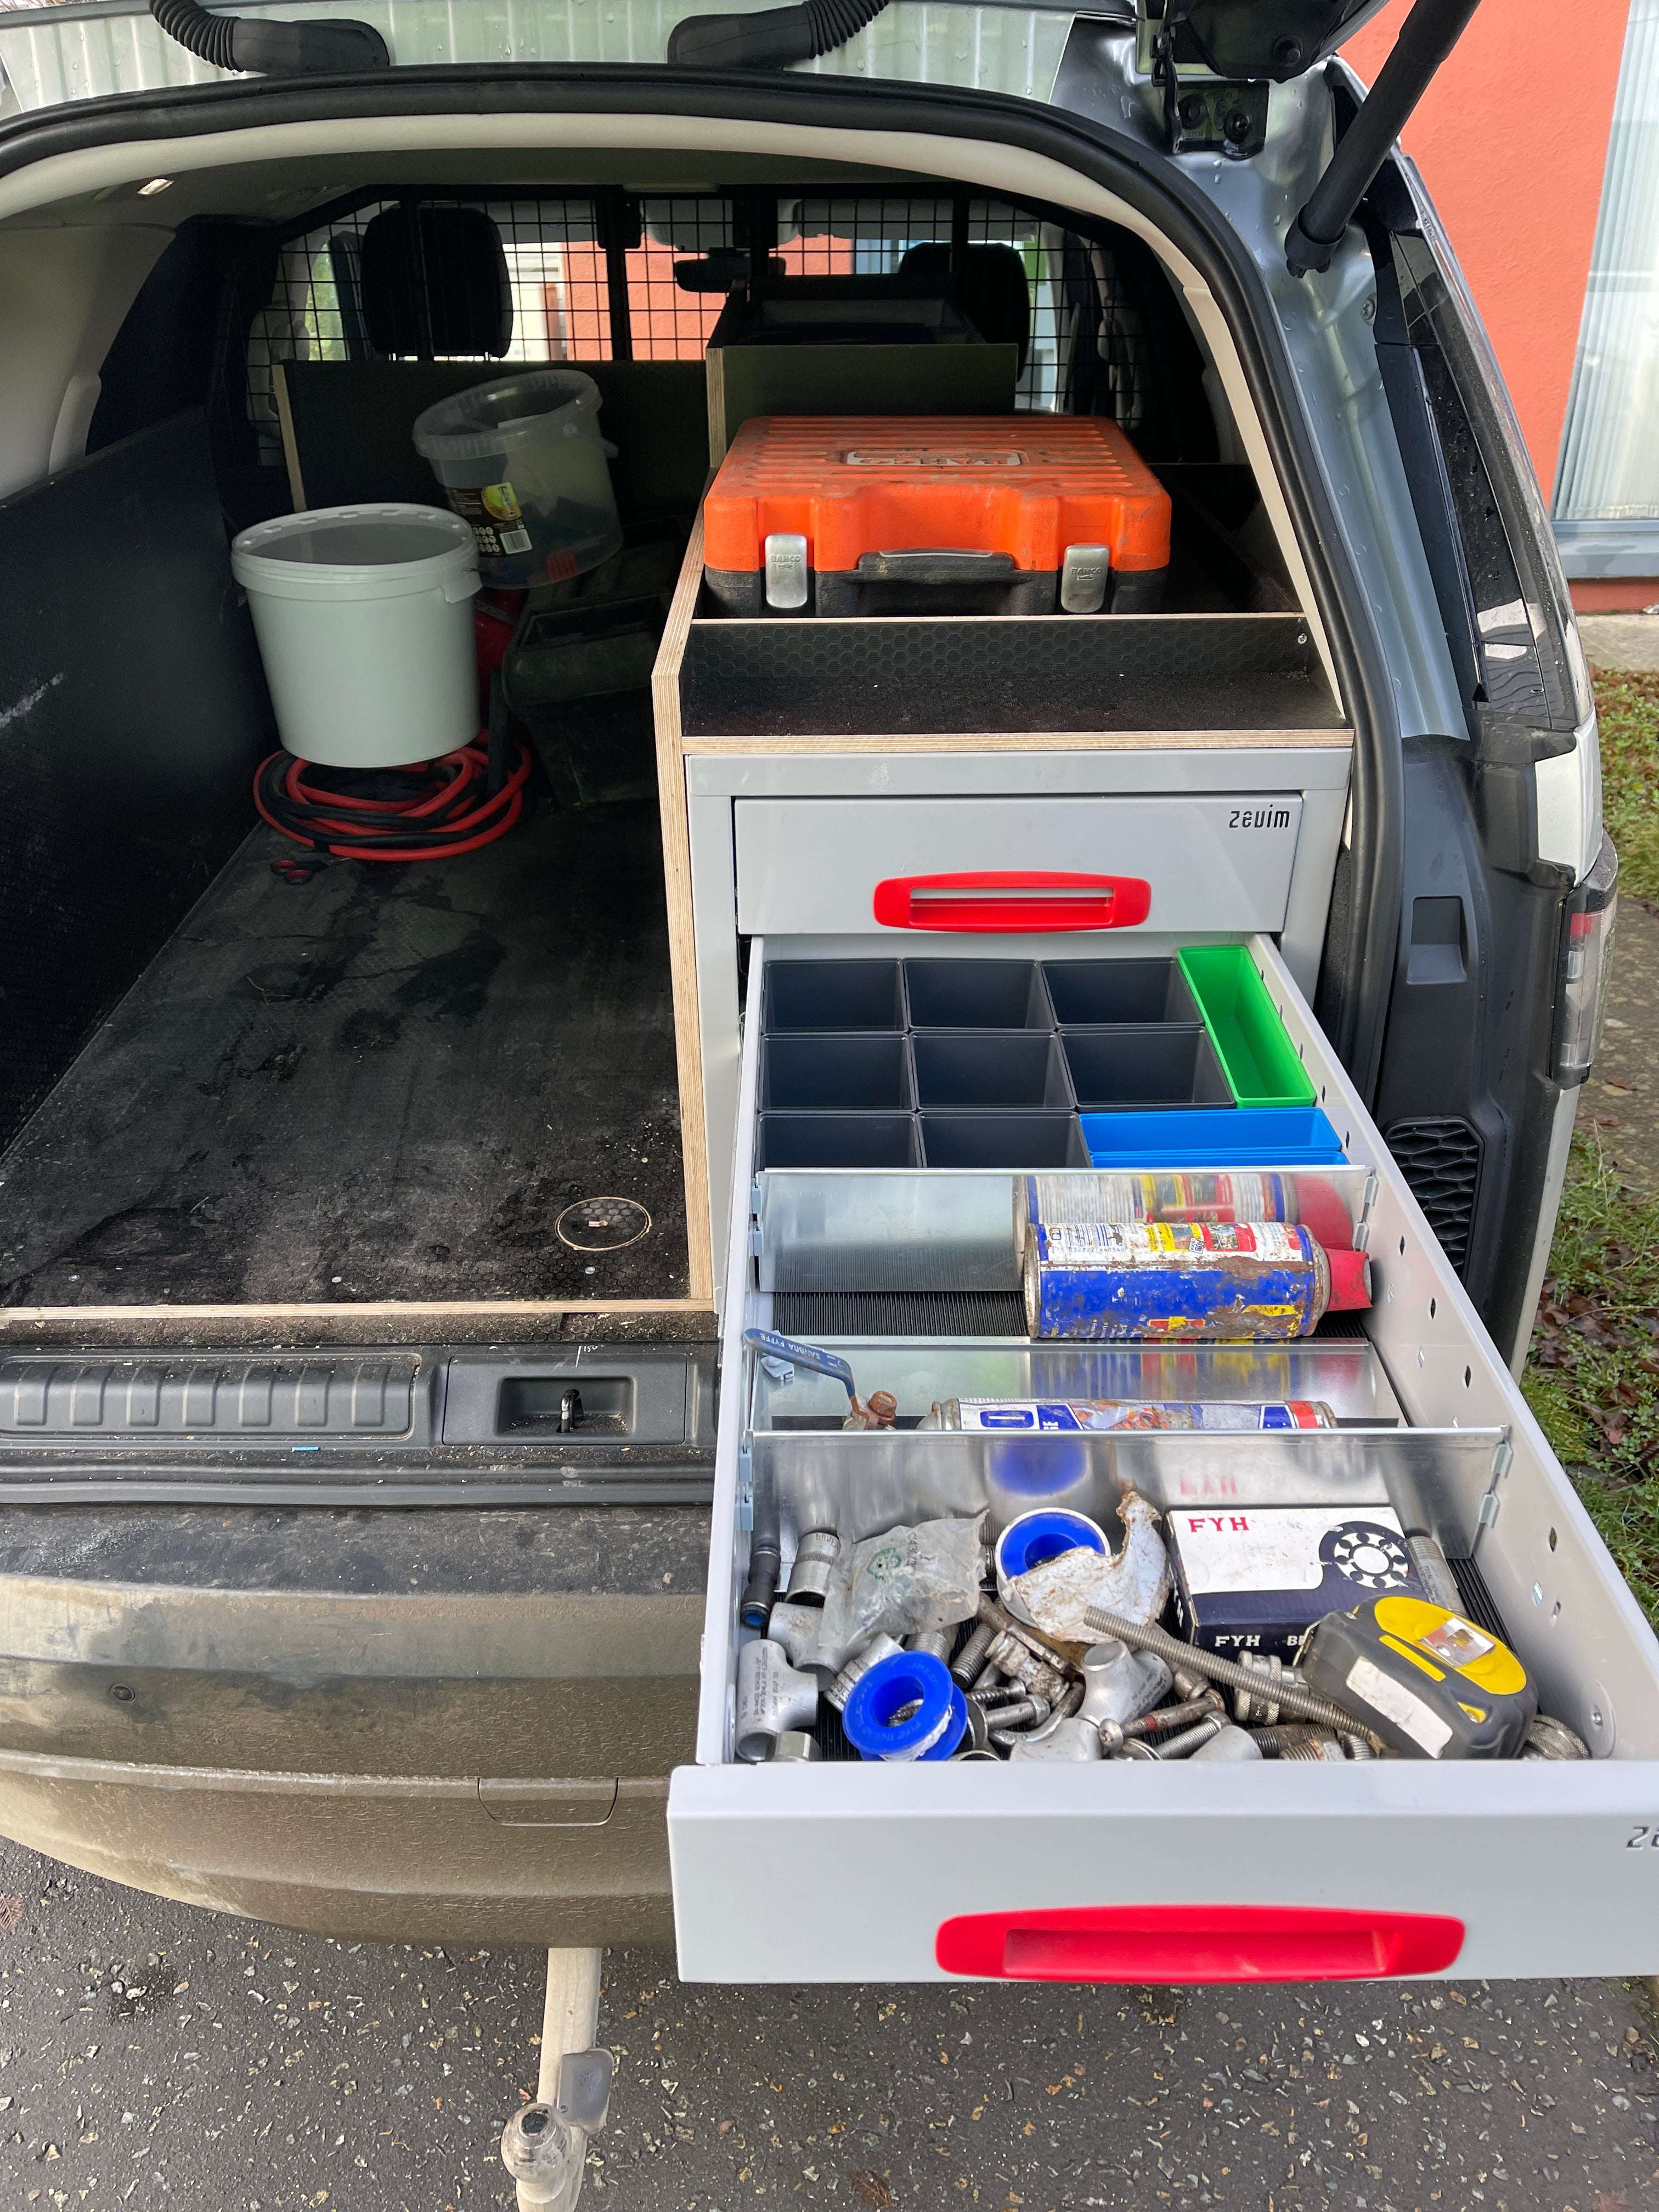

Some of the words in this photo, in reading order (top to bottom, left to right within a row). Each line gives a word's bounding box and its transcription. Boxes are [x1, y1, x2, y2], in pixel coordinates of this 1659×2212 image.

[770, 554, 801, 562] BAHCO
[1070, 567, 1102, 575] BAHCO
[759, 1333, 785, 1348] FYFFE
[1187, 1517, 1250, 1533] FYH
[1214, 1635, 1261, 1647] FYH
